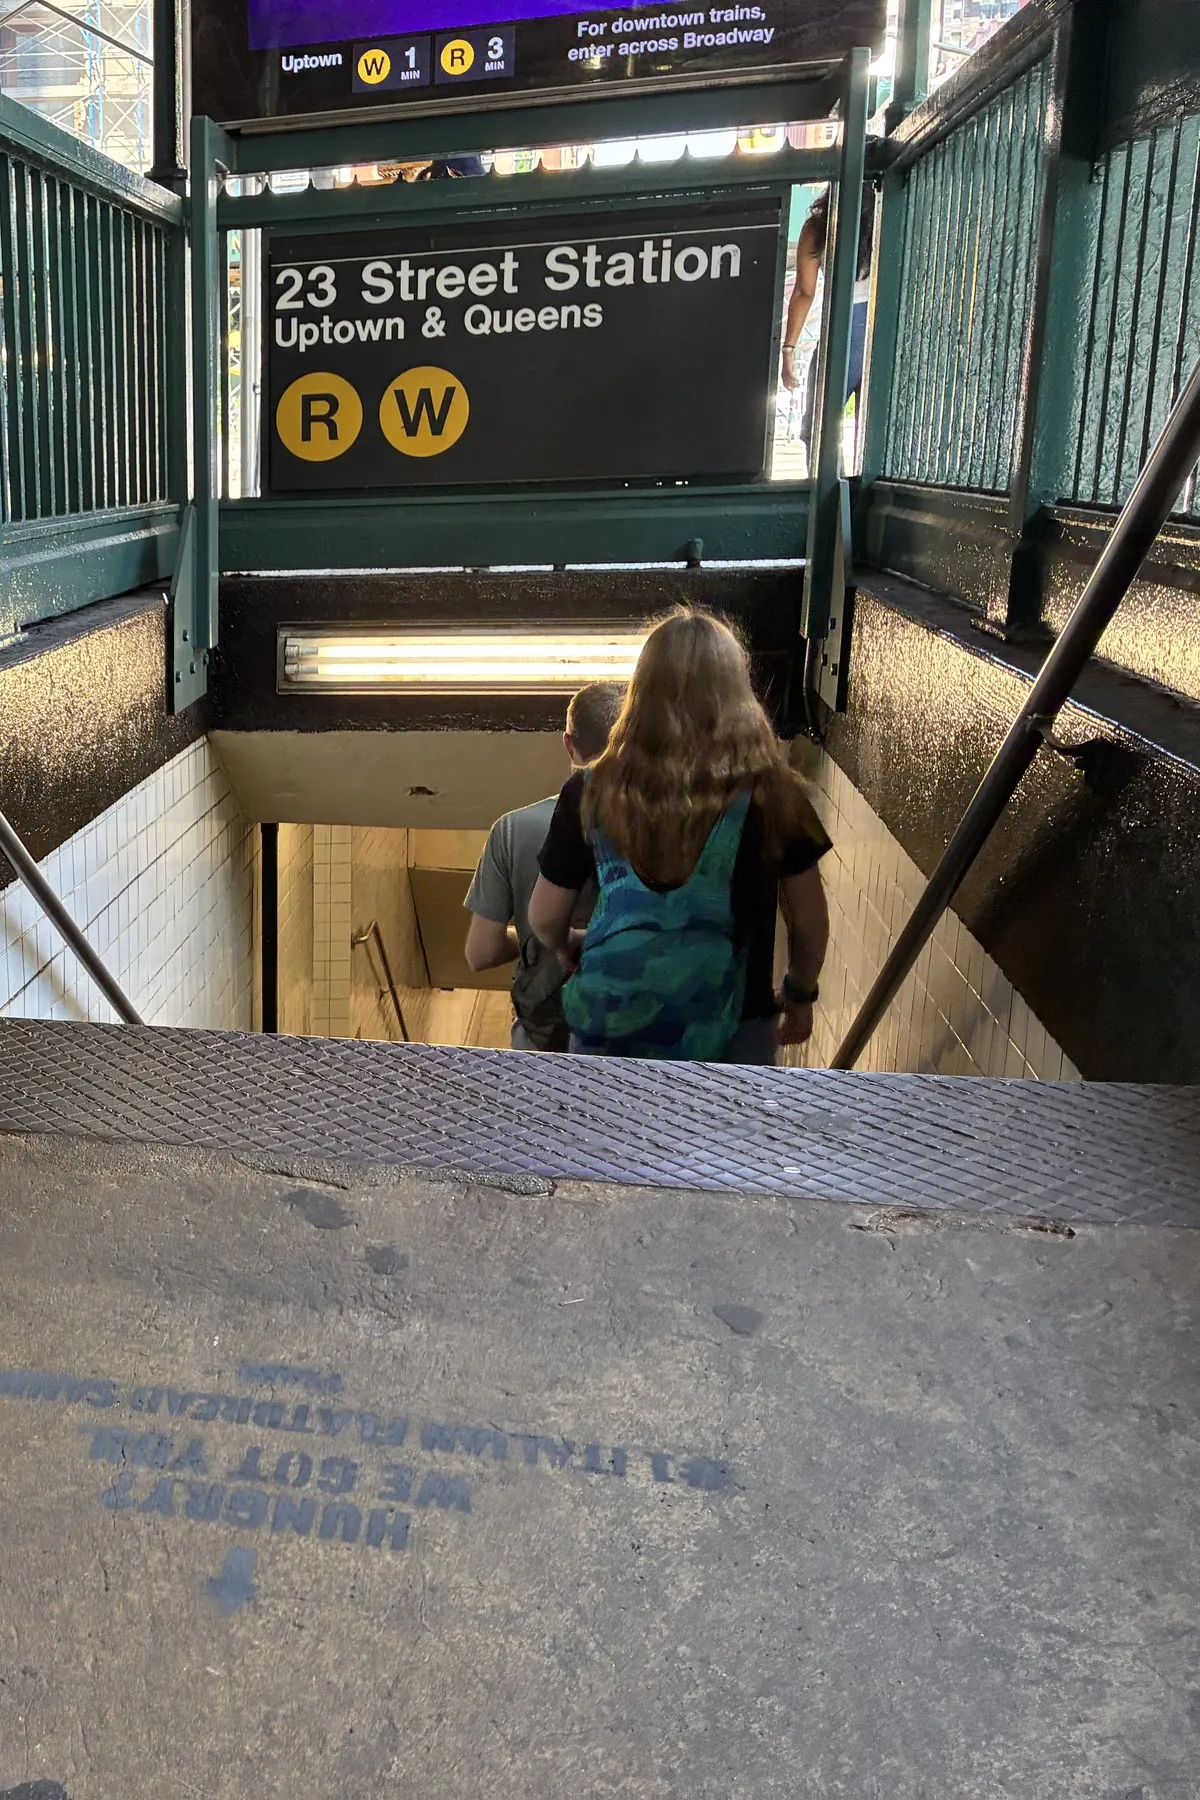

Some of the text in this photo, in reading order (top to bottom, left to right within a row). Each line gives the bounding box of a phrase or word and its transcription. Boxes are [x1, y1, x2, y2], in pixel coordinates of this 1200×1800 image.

[567, 27, 775, 61] enter across Broadway
[577, 5, 766, 38] For downtown trains,
[281, 36, 504, 76] Uptown W 1 R 3
[401, 69, 421, 81] MIN
[485, 60, 505, 72] MIN
[274, 239, 741, 311] 23 Street Station
[274, 302, 604, 351] Uptown & Queens
[301, 386, 456, 442] R W
[229, 1447, 358, 1495] GOT
[377, 1464, 472, 1513] WE
[102, 1472, 410, 1551] HUNGRY?
